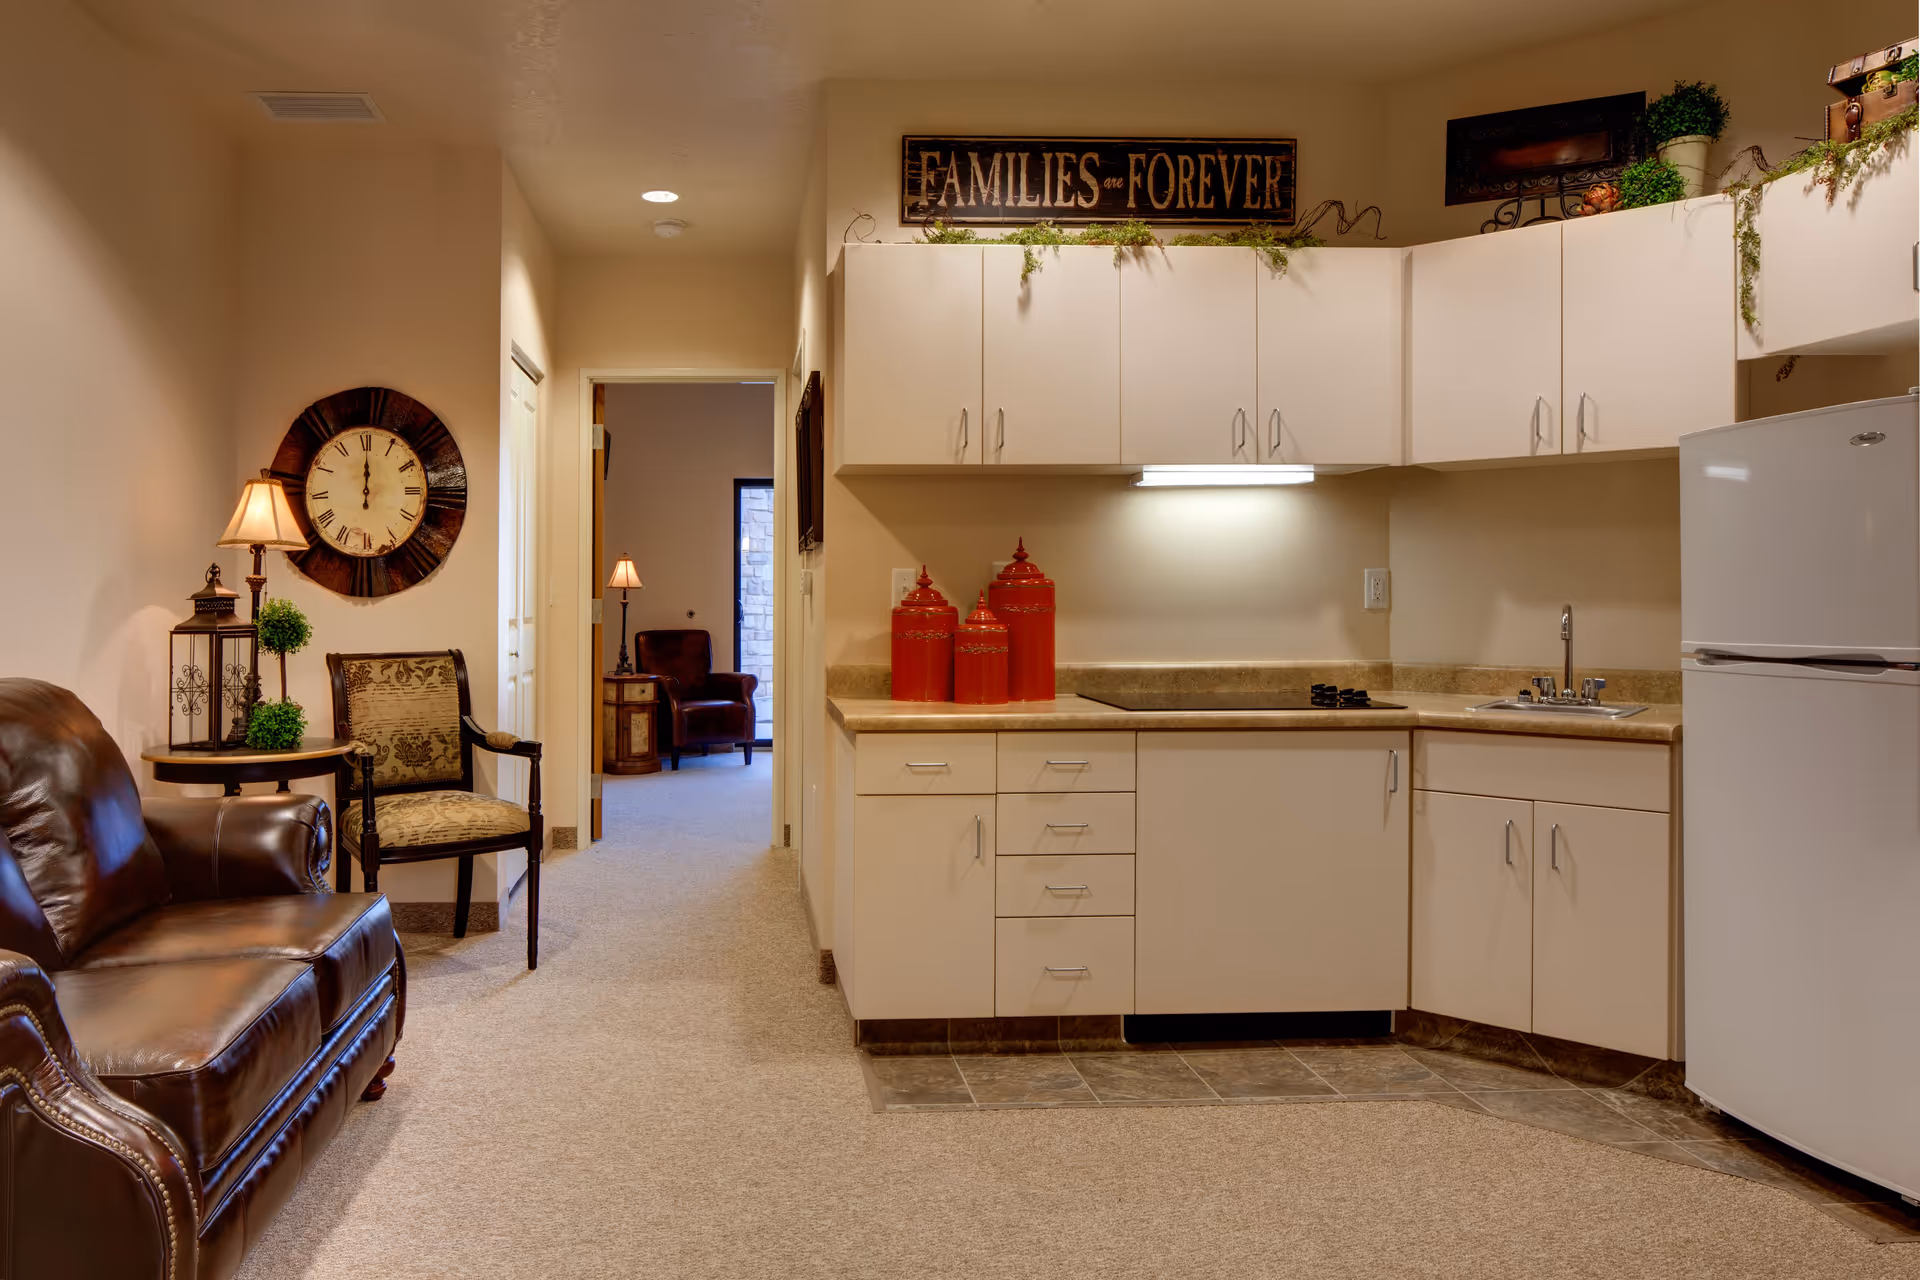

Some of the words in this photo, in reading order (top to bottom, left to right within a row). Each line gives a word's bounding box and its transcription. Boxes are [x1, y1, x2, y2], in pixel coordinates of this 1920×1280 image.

[919, 151, 1100, 209] FAMILIES
[1103, 176, 1124, 189] are
[1126, 152, 1282, 209] FOREVER
